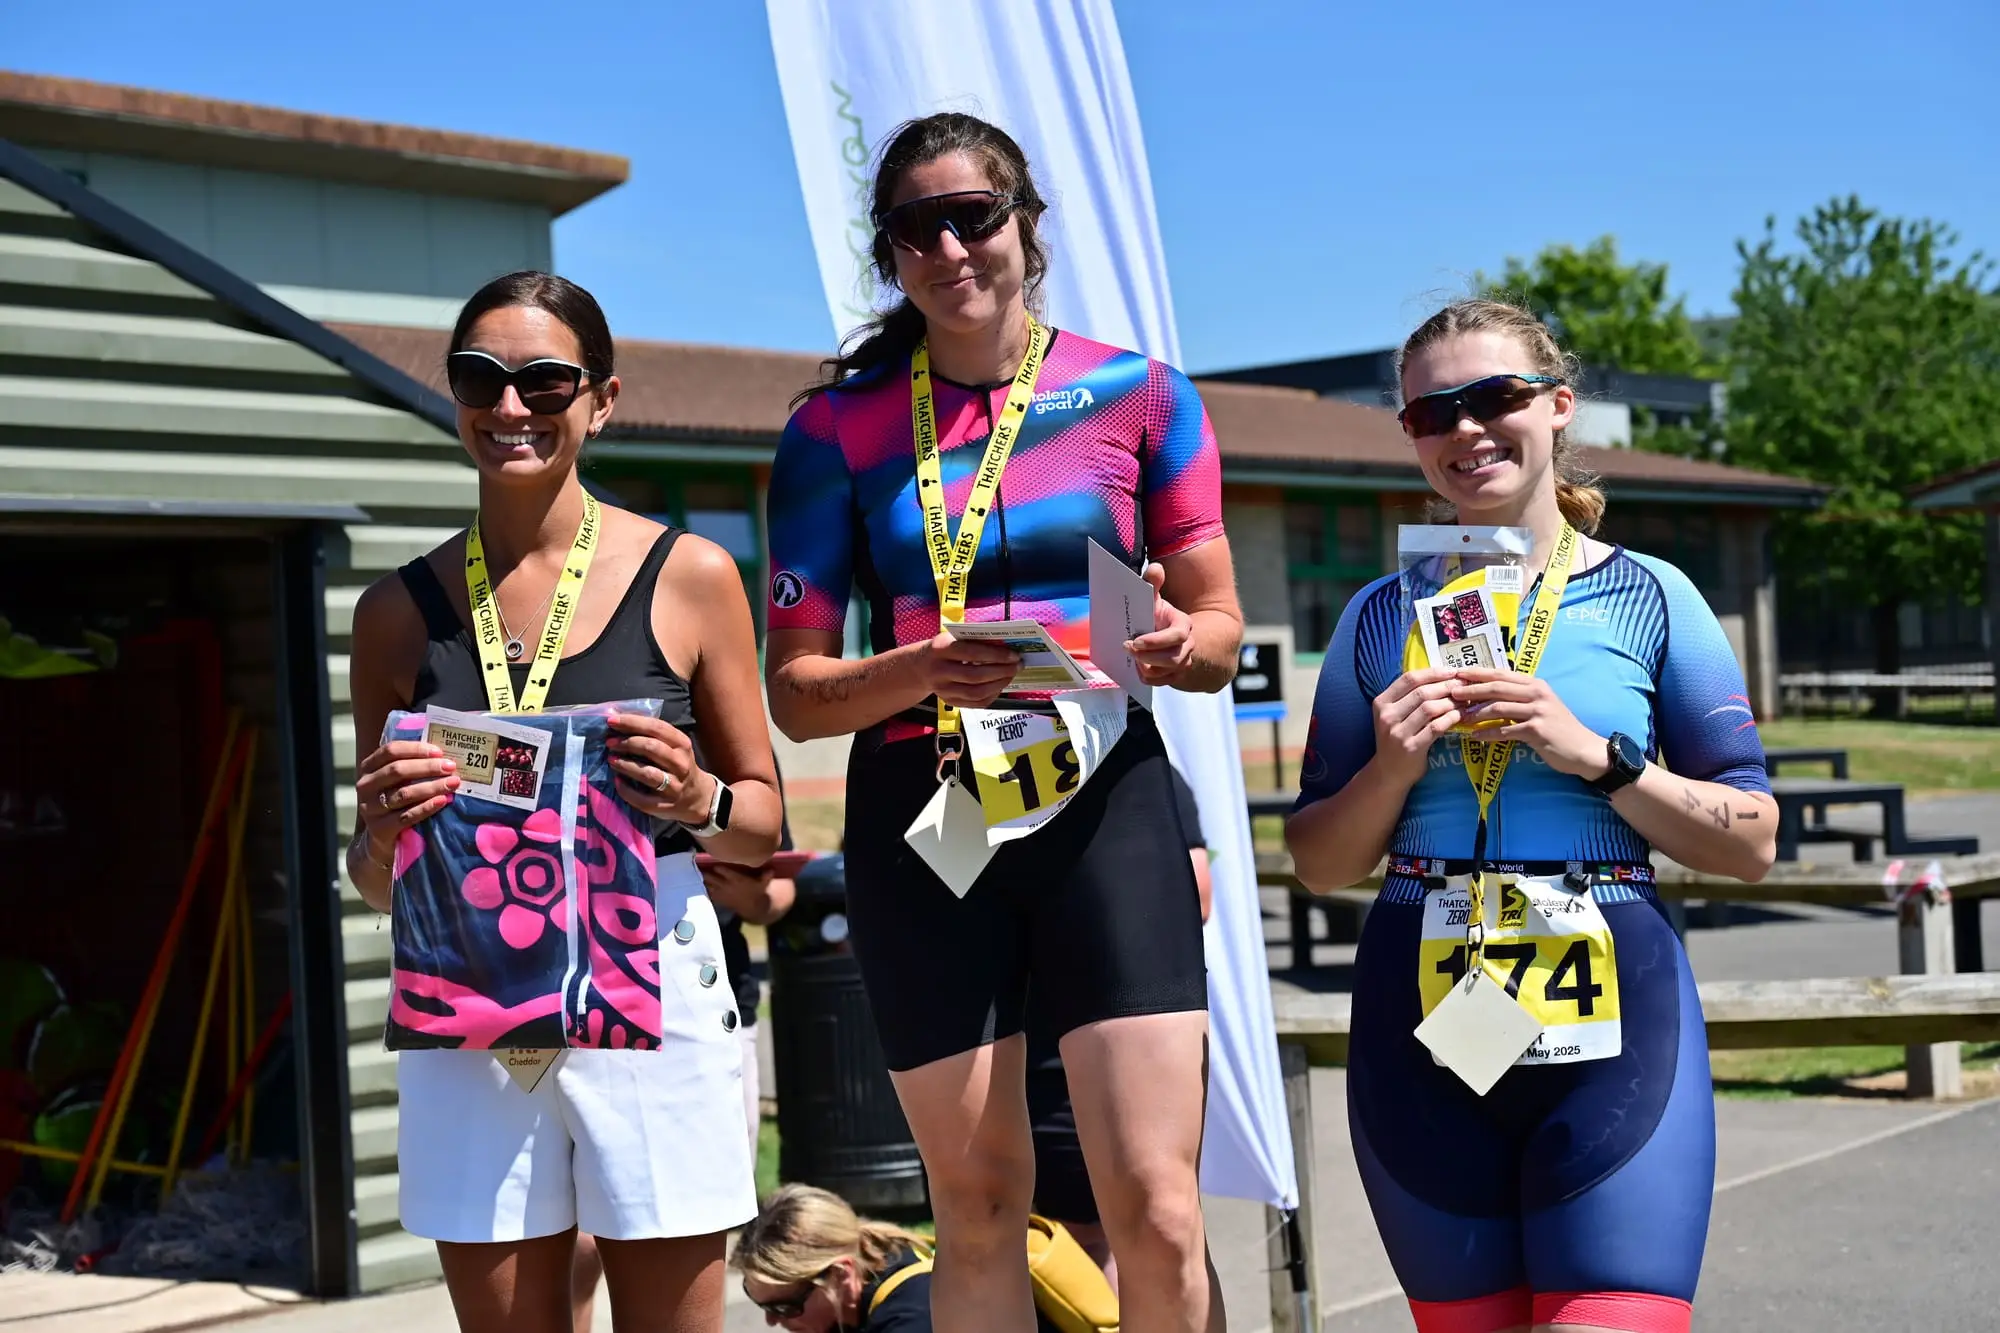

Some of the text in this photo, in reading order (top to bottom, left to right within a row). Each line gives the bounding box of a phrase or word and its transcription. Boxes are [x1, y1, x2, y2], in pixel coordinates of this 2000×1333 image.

[1030, 389, 1072, 402] tolen
[1035, 400, 1073, 415] goat
[917, 392, 936, 461] THATCHERS
[976, 423, 1012, 488] THATCHERS
[944, 531, 973, 602] THATCHERS
[474, 577, 498, 644] THATCHERS
[537, 591, 571, 660] THATCHERS
[1514, 607, 1548, 673] THATCHERS
[1460, 644, 1478, 666] £20
[981, 713, 1034, 730] THATCHERS
[442, 729, 487, 744] THATCHERS
[457, 741, 480, 751] VOUCHER
[465, 752, 489, 768] £20
[1499, 864, 1524, 872] World
[1438, 898, 1472, 909] THATCH
[1446, 909, 1471, 926] ZERO
[1501, 908, 1524, 922] TRI
[1527, 1045, 1581, 1059] May 2025
[509, 1057, 541, 1066] Cheddar
